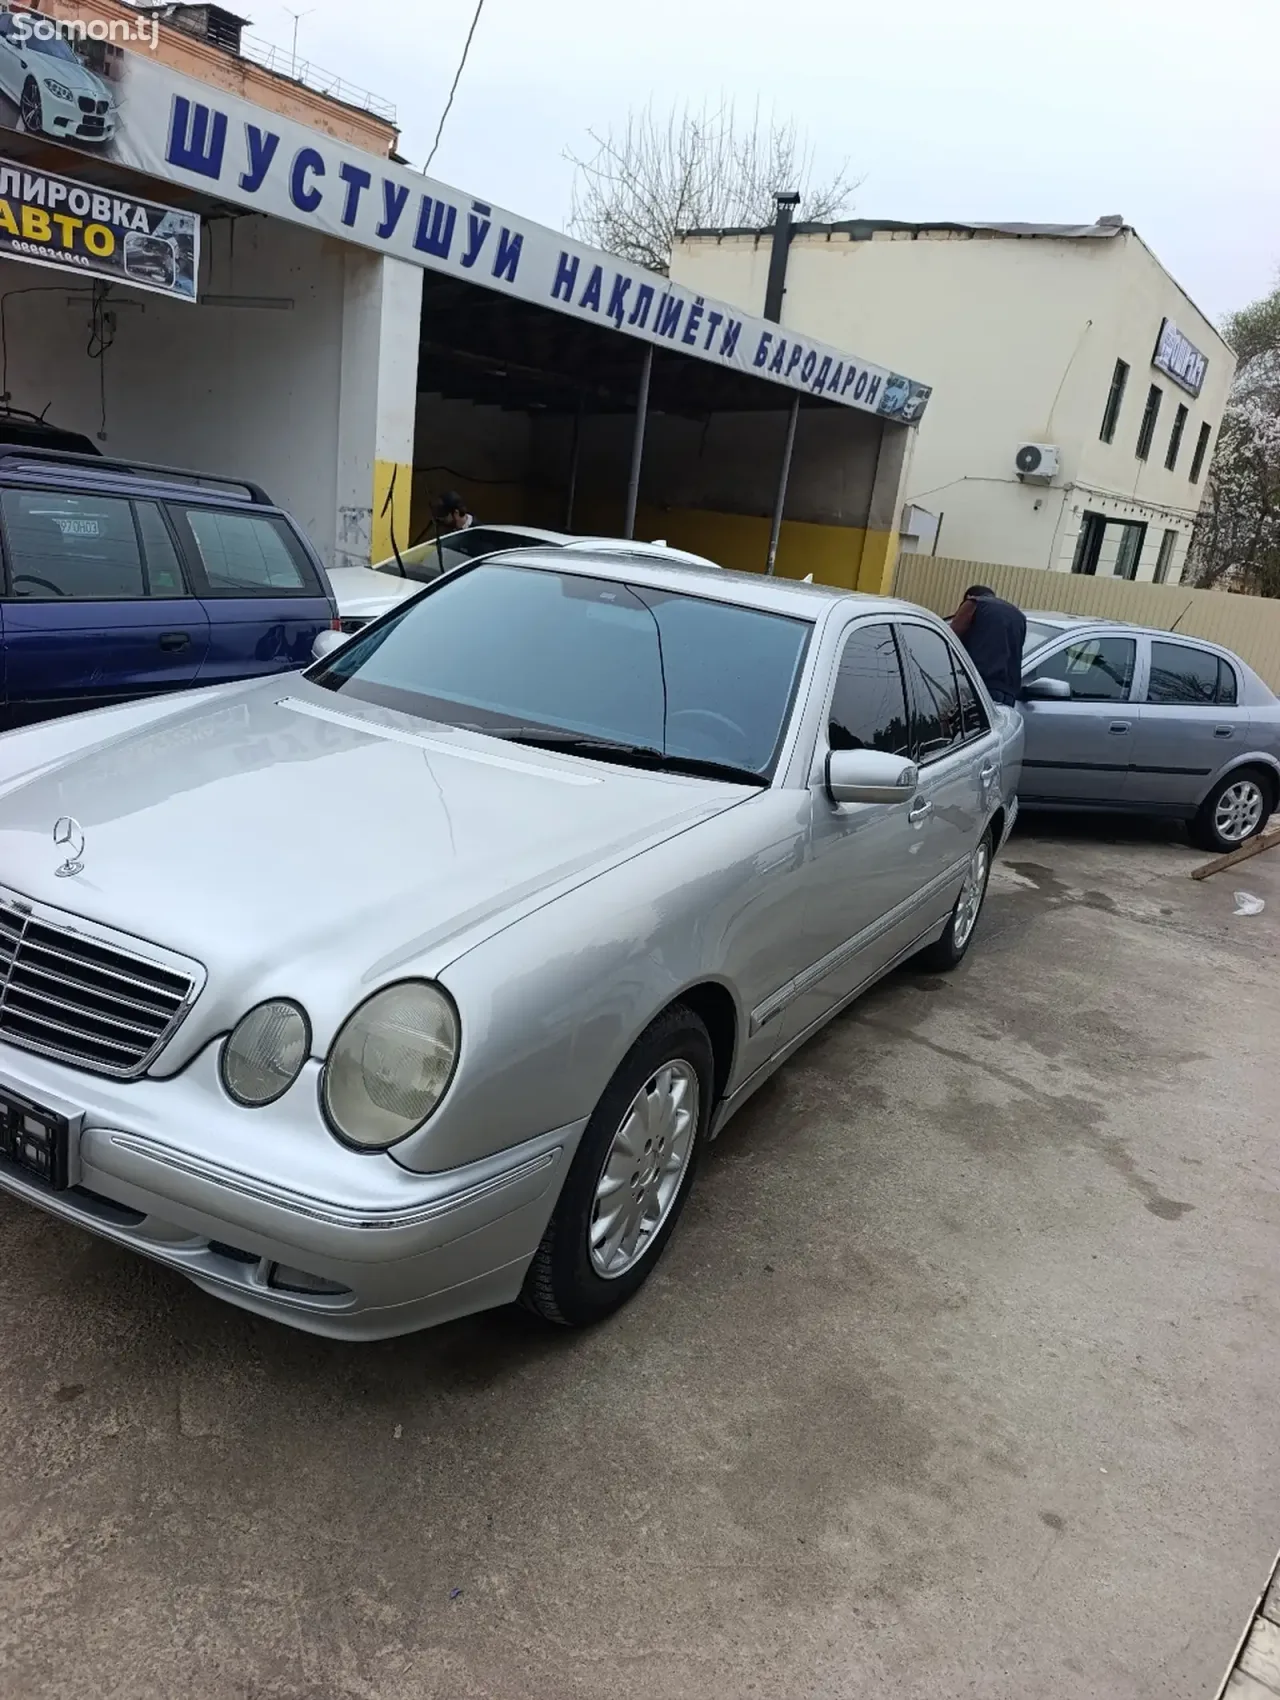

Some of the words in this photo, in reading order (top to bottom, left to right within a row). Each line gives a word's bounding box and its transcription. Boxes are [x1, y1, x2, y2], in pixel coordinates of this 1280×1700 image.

[0, 199, 115, 257] АВТО
[164, 92, 525, 283] ШУСТУШӮИ
[753, 333, 881, 404] БАРОДАРОН
